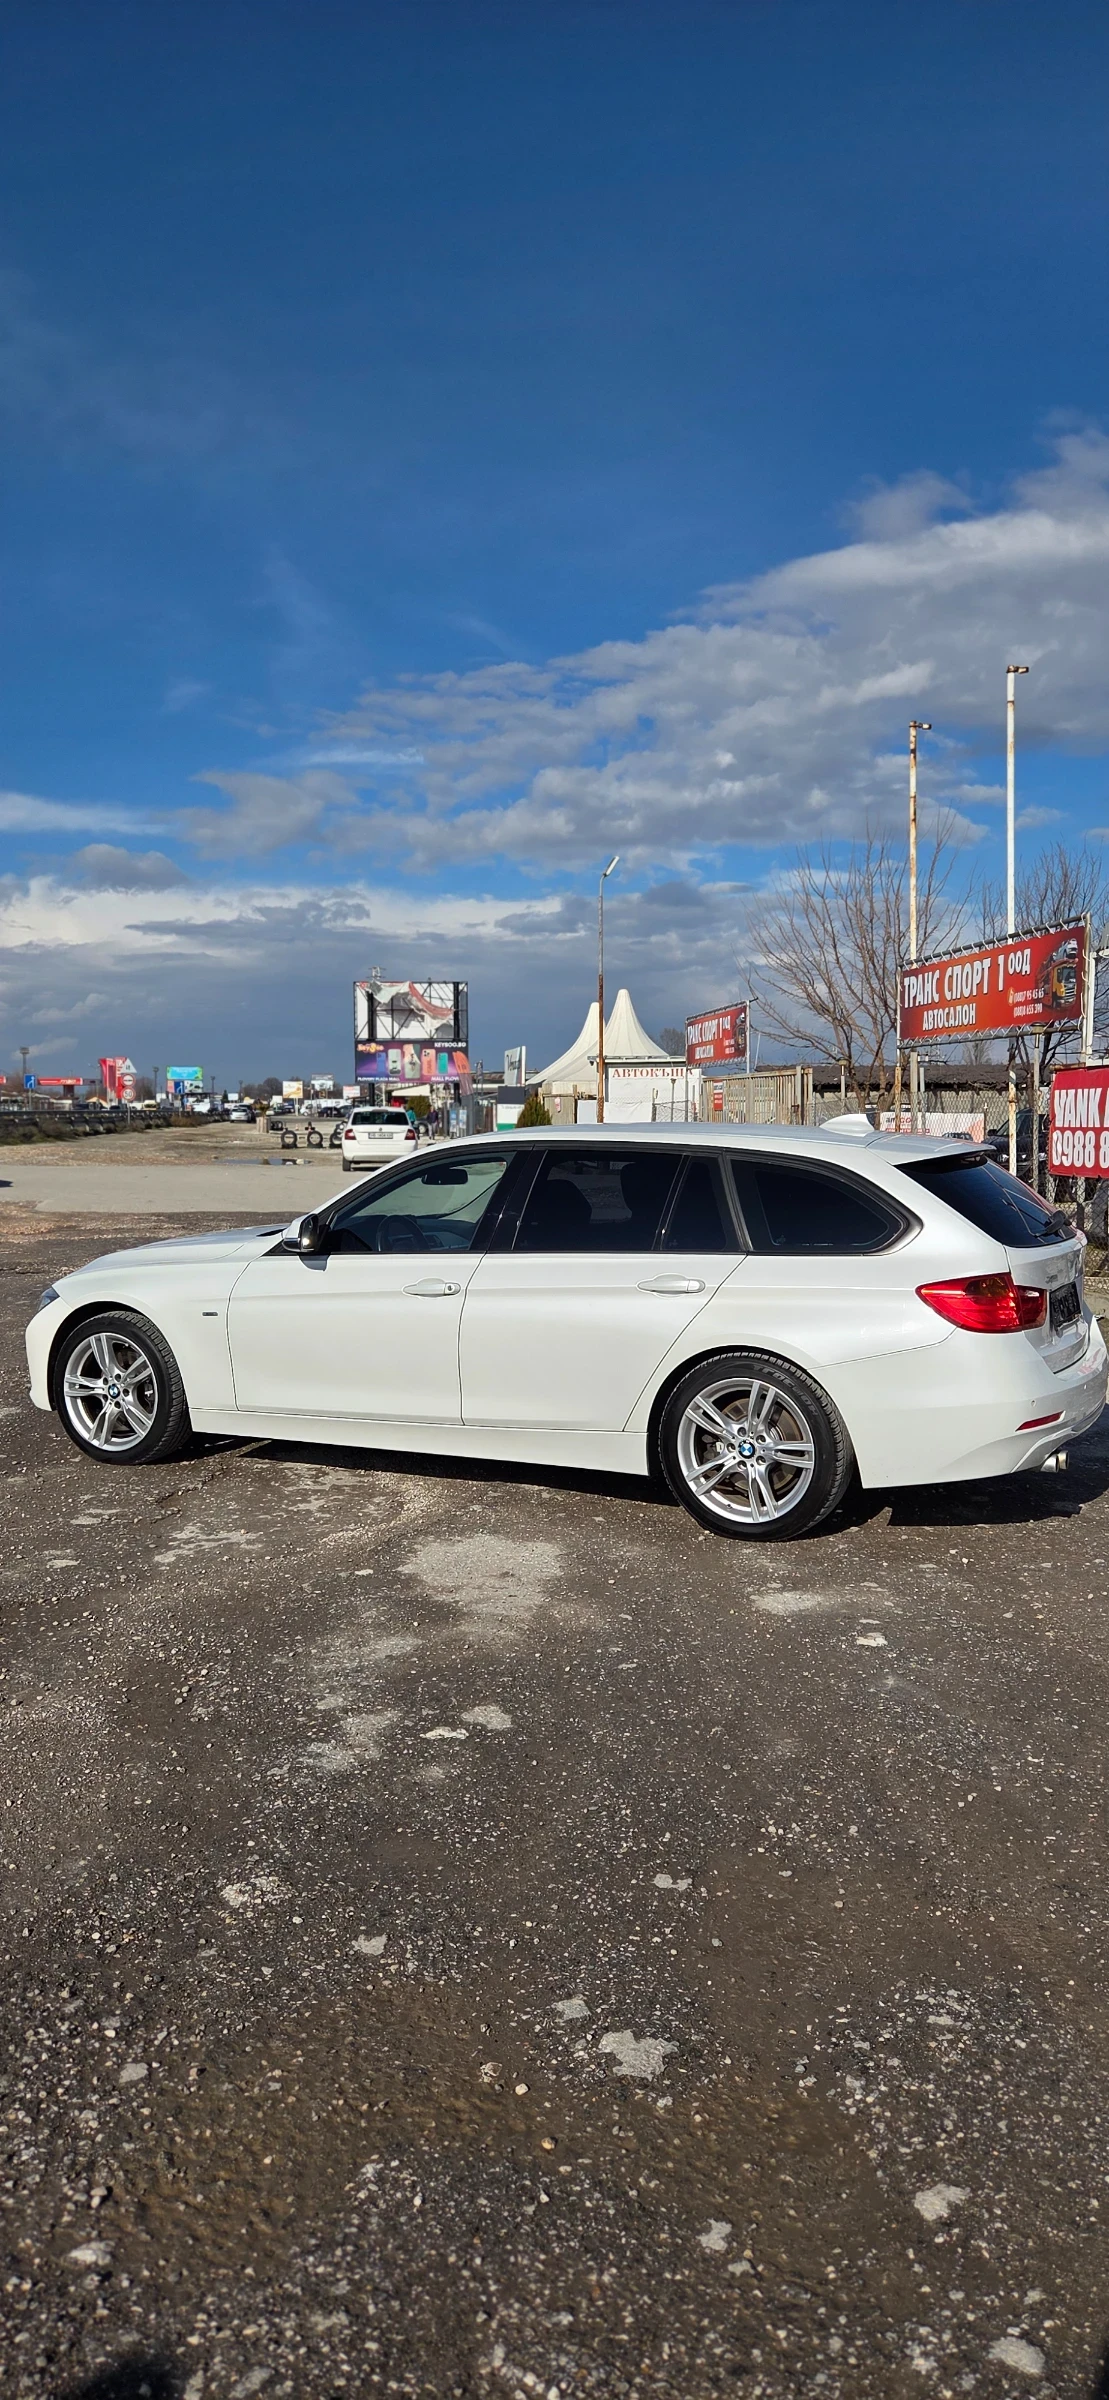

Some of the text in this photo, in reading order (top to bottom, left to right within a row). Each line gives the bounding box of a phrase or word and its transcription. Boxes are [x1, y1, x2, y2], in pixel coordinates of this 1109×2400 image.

[904, 948, 1031, 1008] ТРАНС СПОРТ 1 ООД
[922, 1002, 976, 1031] АВТОСАЛОН
[1054, 1087, 1103, 1128] YANK
[1052, 1129, 1096, 1169] 0988
